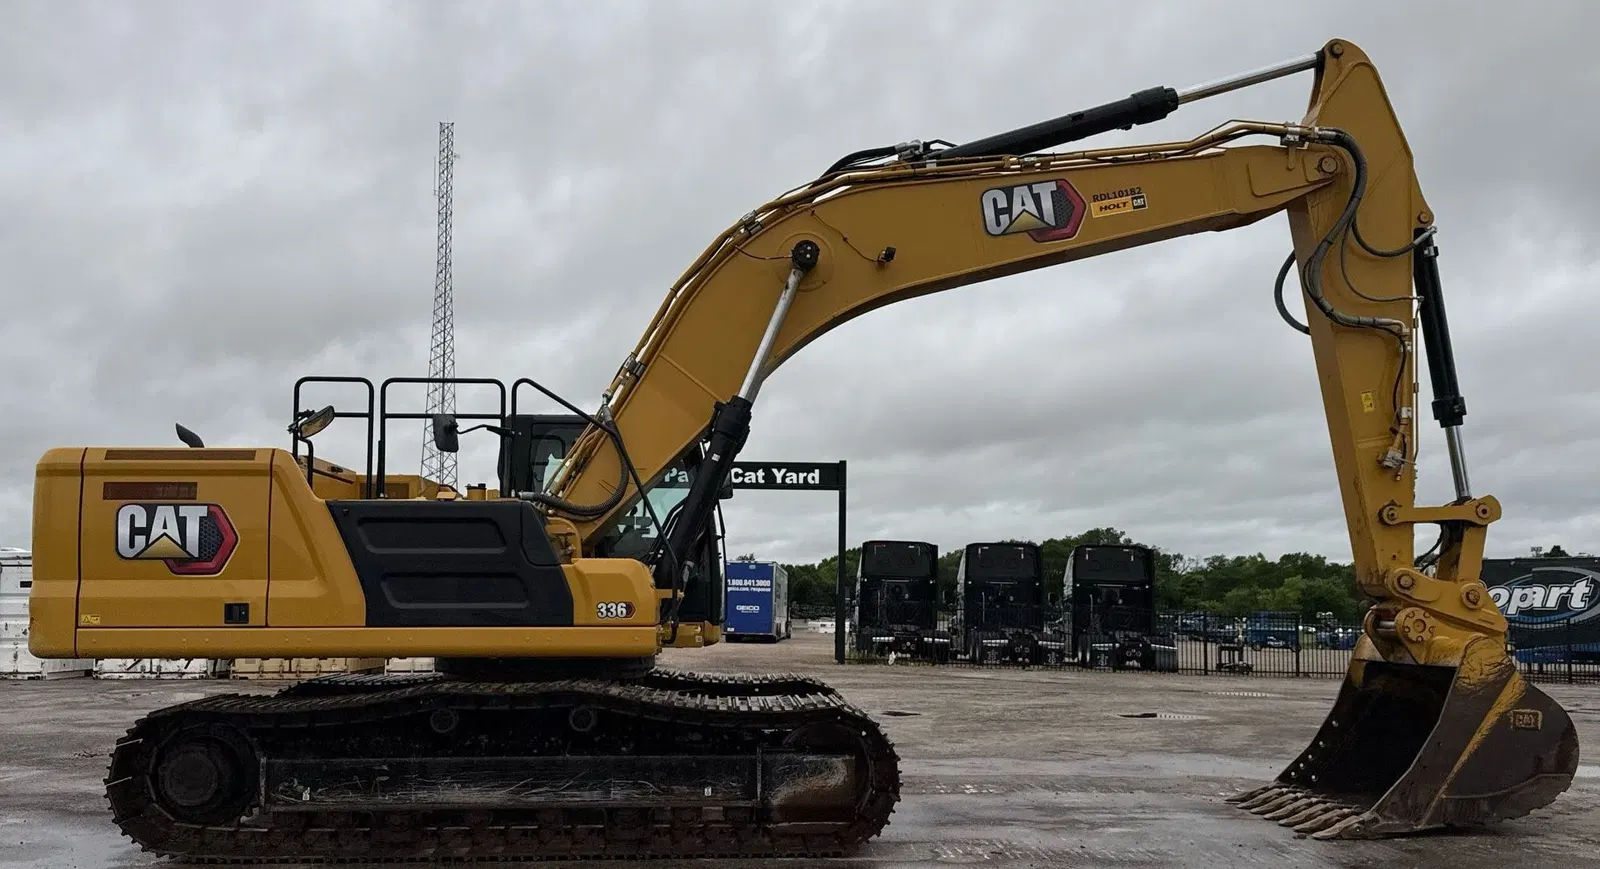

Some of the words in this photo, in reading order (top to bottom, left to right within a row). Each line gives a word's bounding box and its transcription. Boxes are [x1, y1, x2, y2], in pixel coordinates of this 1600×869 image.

[1093, 187, 1142, 202] RDL10182
[982, 181, 1057, 235] CAT
[1099, 201, 1128, 211] HOLT
[1133, 198, 1145, 207] CAT
[731, 468, 765, 483] Cat
[772, 468, 820, 484] Yard
[117, 504, 208, 558] CAT
[1480, 575, 1594, 616] opart
[597, 602, 627, 618] 336
